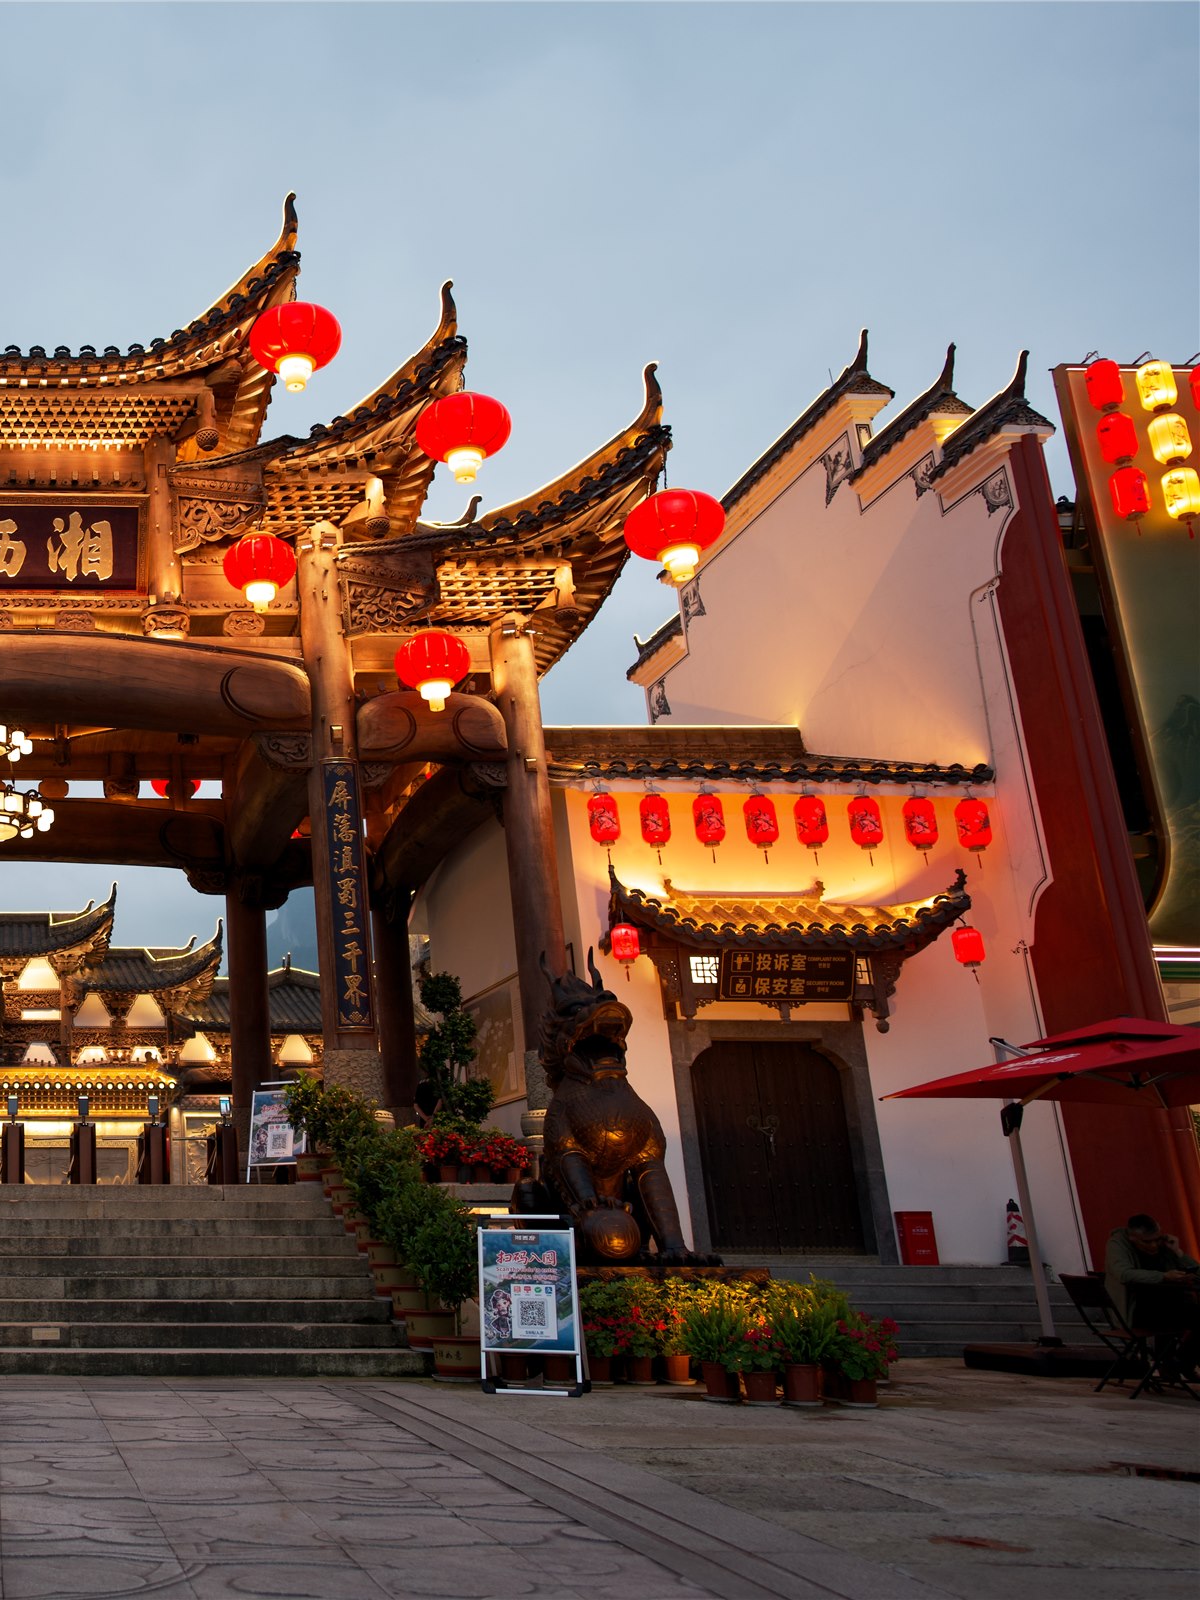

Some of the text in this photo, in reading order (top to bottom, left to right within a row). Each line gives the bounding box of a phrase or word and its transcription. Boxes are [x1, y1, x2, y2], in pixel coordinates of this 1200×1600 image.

[756, 953, 807, 972] 投诉室
[754, 977, 806, 996] 保安室
[496, 1250, 558, 1267] 扫码入园
